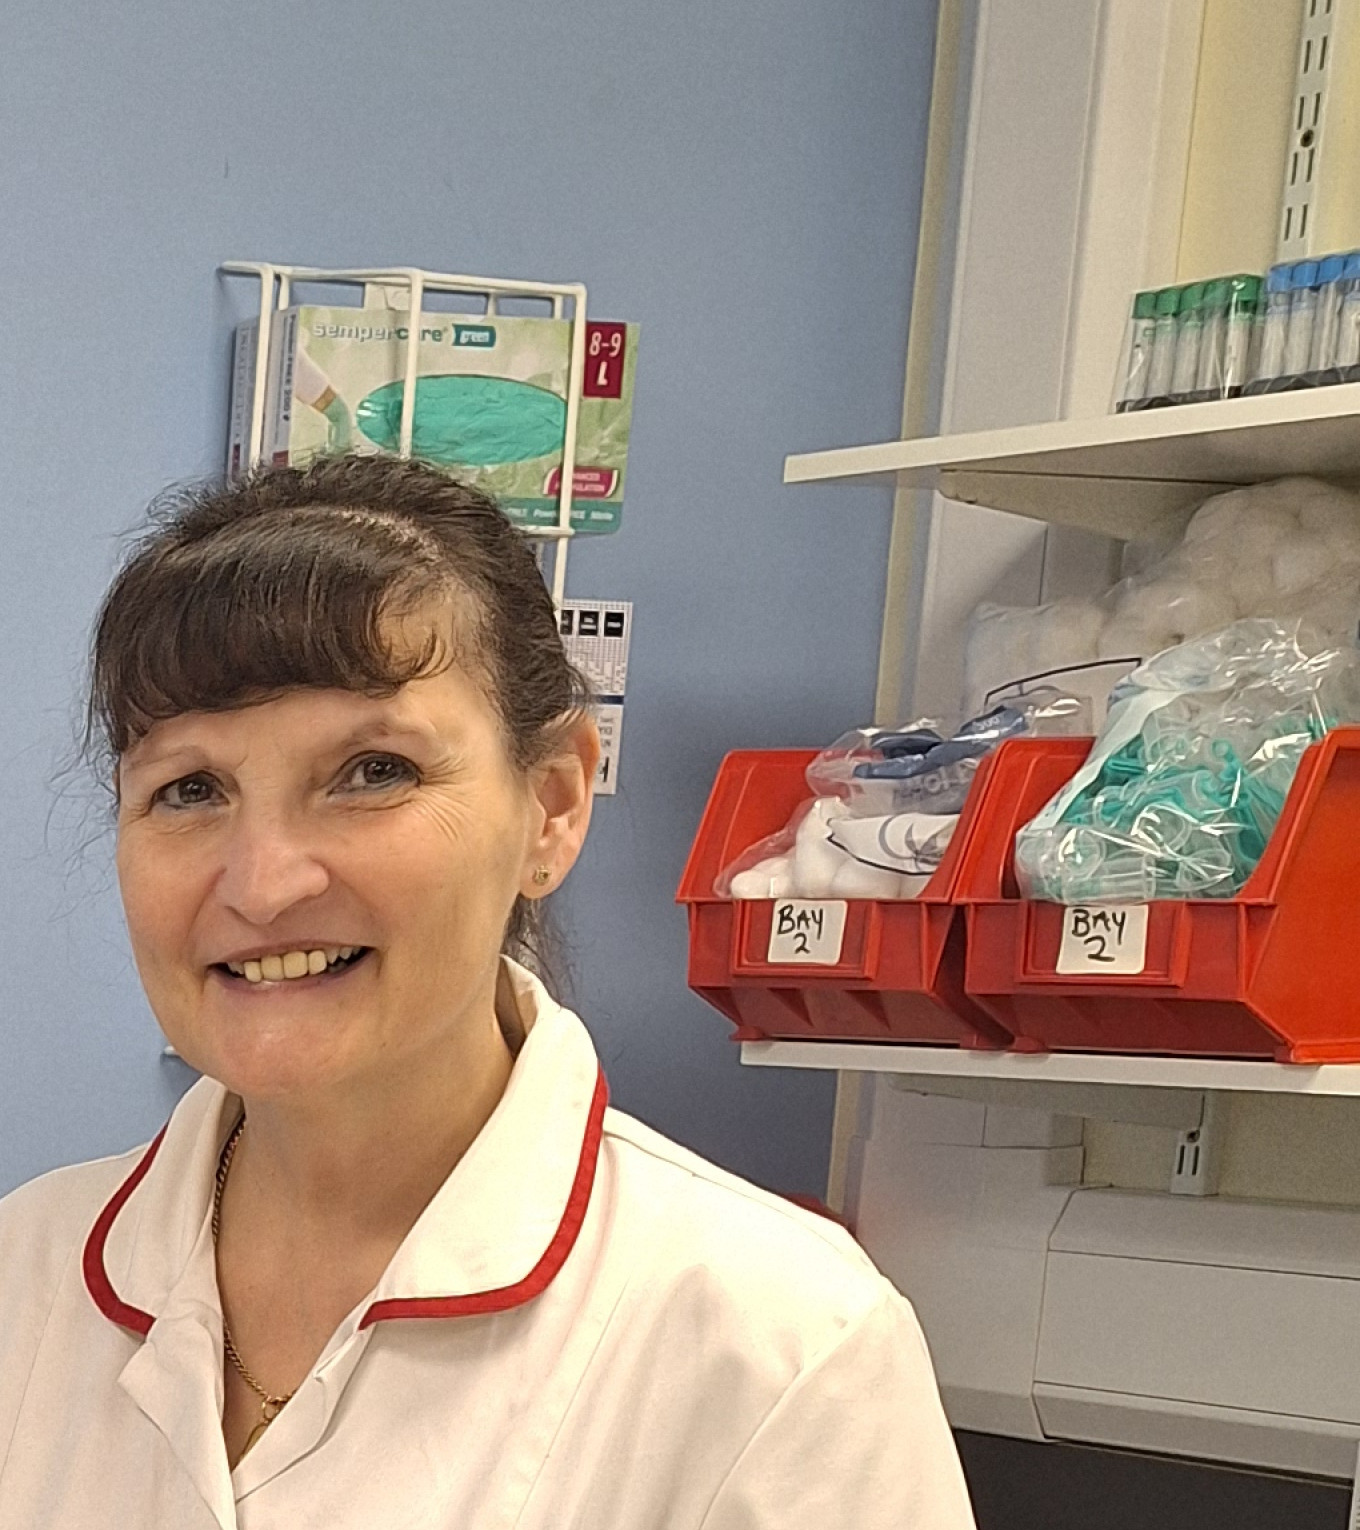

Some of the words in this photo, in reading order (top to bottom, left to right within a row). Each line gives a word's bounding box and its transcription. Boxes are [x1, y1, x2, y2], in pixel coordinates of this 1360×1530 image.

[313, 324, 444, 343] sempercre
[589, 331, 622, 357] 8-9
[777, 904, 824, 940] BAY
[1071, 908, 1126, 945] BAY
[793, 933, 810, 954] 2
[1083, 935, 1115, 962] 2
